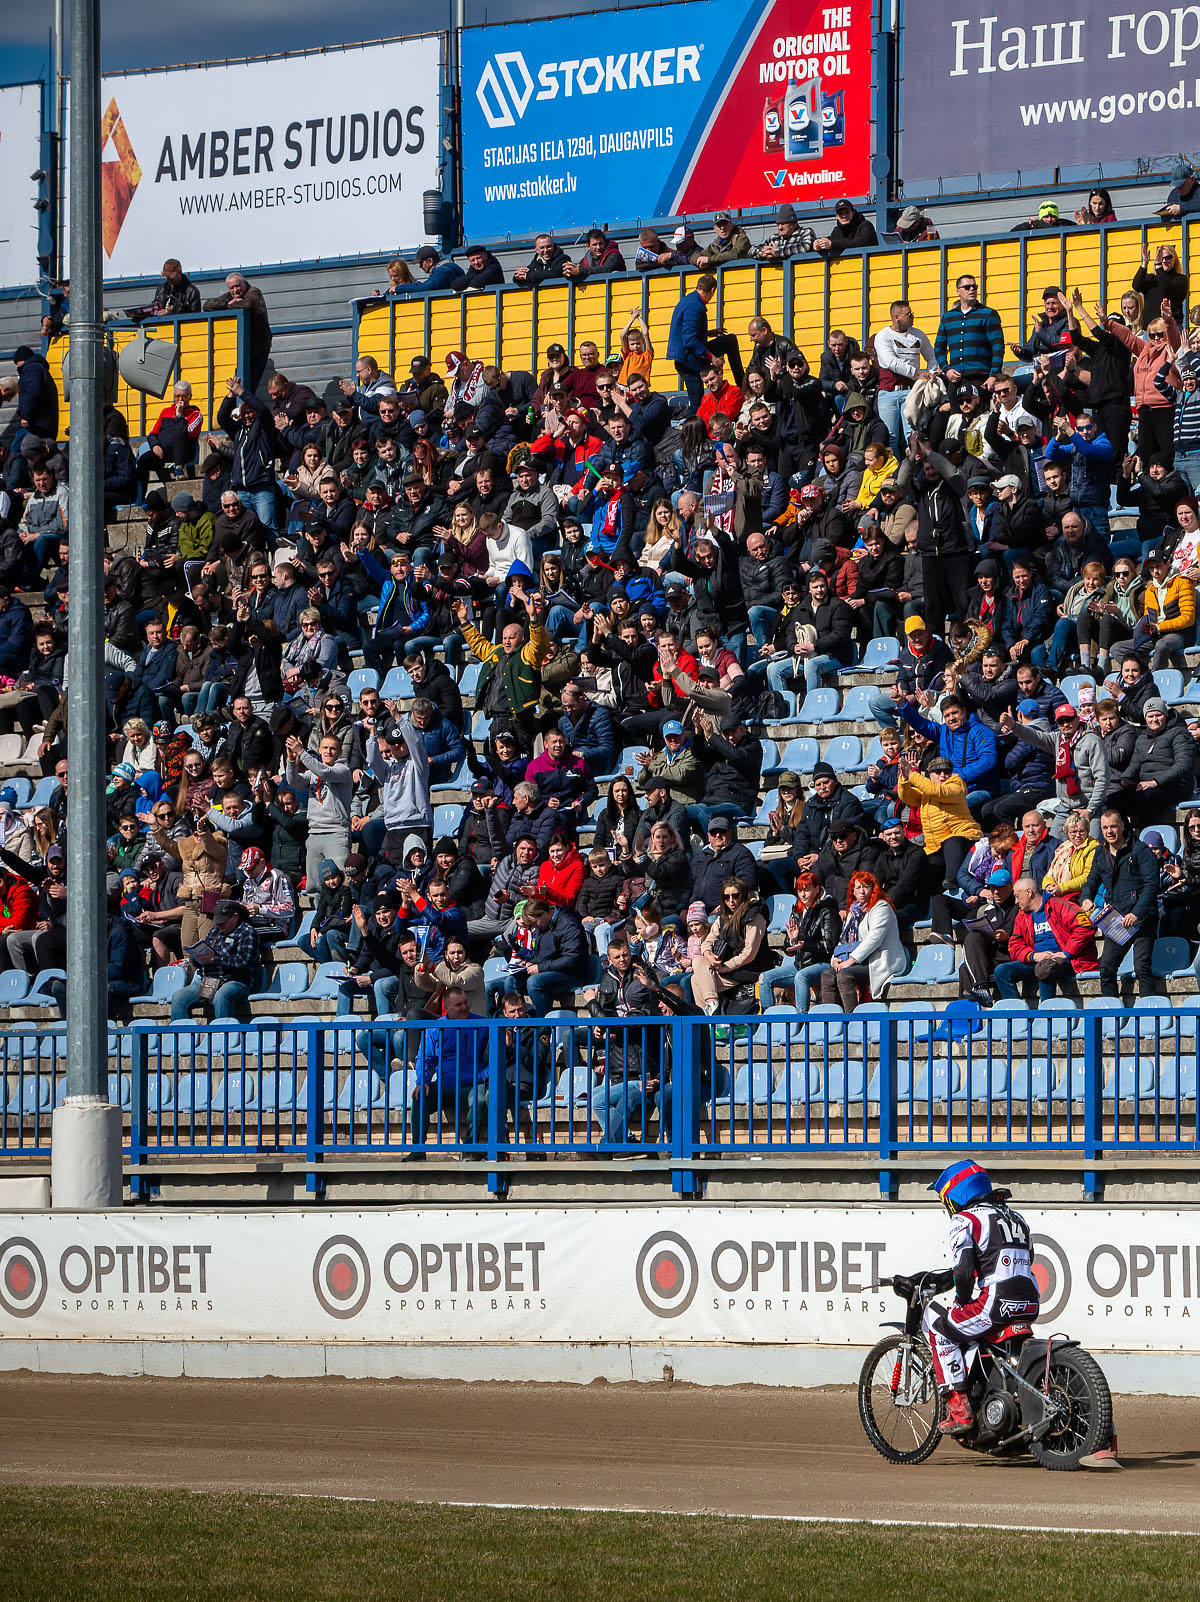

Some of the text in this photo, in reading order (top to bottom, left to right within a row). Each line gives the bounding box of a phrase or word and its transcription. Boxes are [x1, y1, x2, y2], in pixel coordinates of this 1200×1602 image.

[822, 6, 852, 30] THE
[772, 30, 851, 59] ORIGINAL
[949, 16, 1102, 78] Наш
[535, 45, 702, 101] STOKKER
[758, 54, 851, 84] MOTOR OIL
[154, 105, 427, 183] AMBER STUDIOS
[483, 126, 674, 169] STACIJAS IELA 129d, DAUGAVPILS
[484, 171, 578, 203] www.stokker.lv
[787, 169, 847, 187] Valvoline
[178, 172, 404, 217] WWW.AMBER-STUDIOS.COM
[996, 1217, 1027, 1244] 14
[59, 1244, 212, 1294] OPTIBET
[384, 1241, 546, 1294] OPTIBET
[711, 1240, 887, 1293] OPTIBET
[61, 1296, 213, 1311] SPORTA BĀRS
[385, 1294, 547, 1311] SPORTA BĀRS
[713, 1294, 887, 1314] SPORTA BĀRS
[1087, 1304, 1192, 1317] SPORTA
